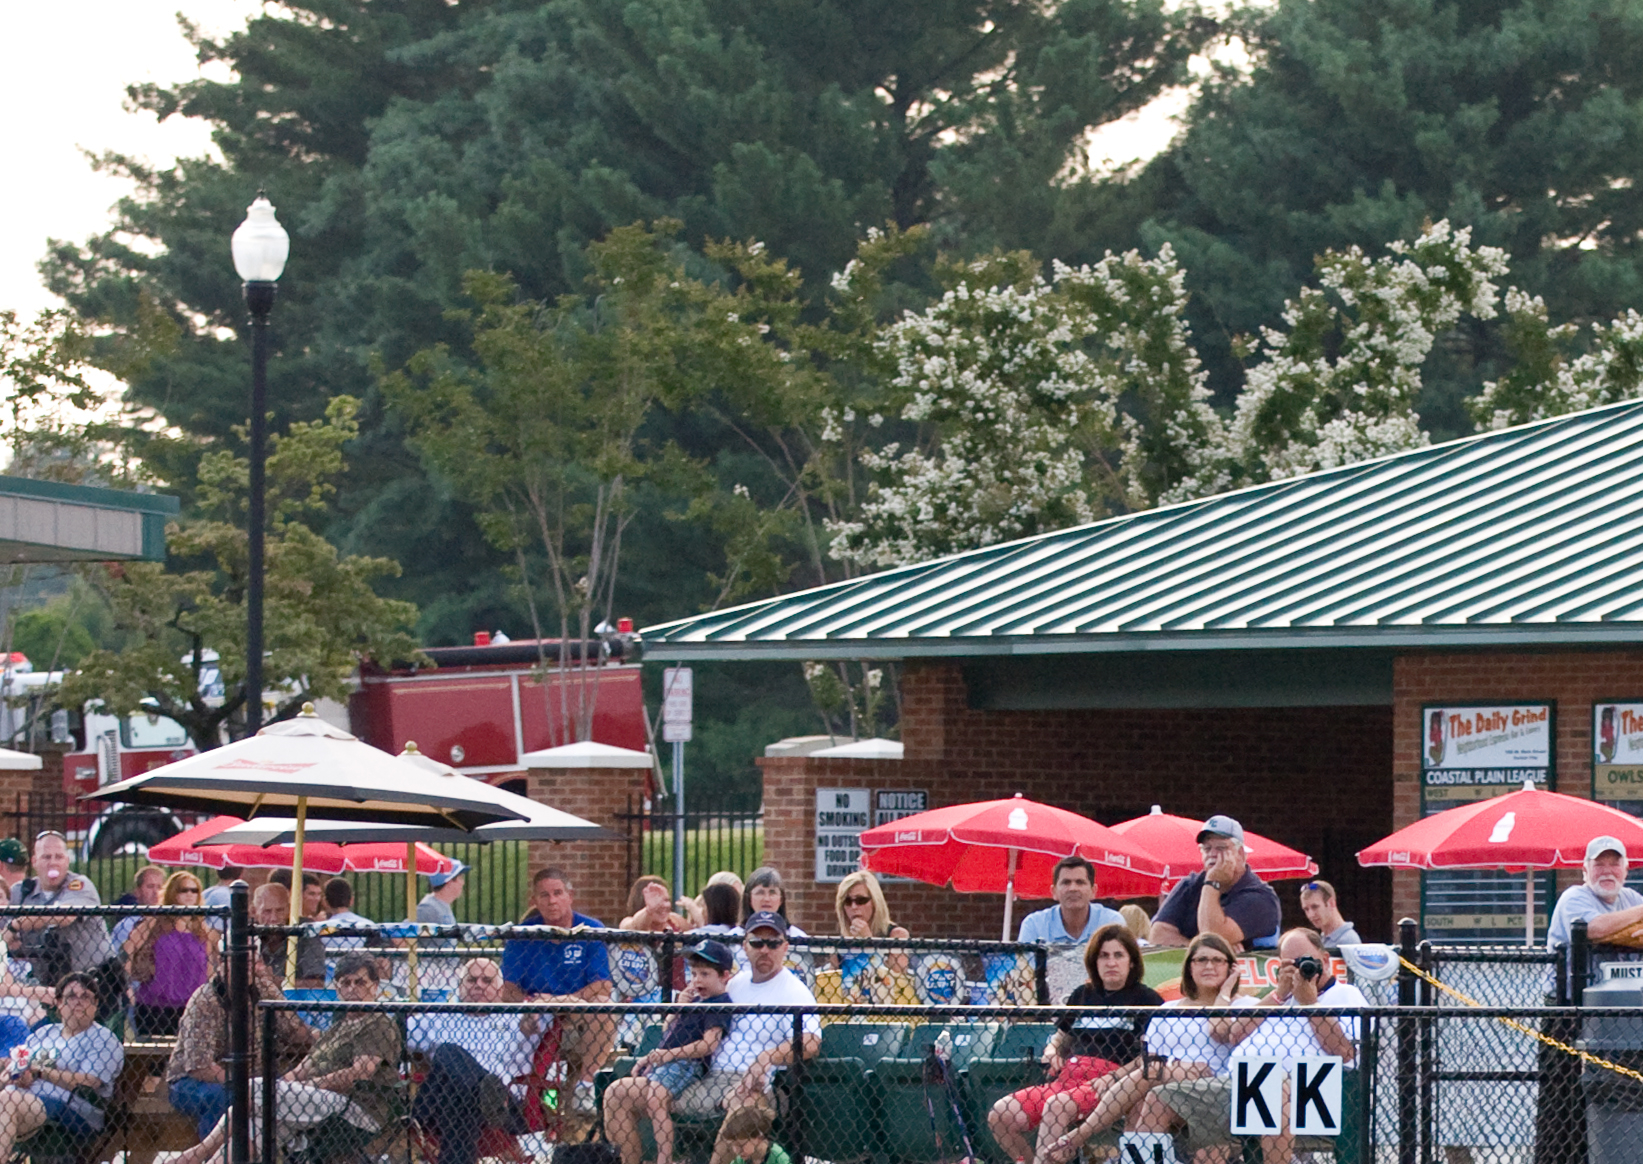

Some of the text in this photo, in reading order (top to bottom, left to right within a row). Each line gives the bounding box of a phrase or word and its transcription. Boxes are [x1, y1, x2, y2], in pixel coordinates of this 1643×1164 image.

[1449, 708, 1547, 738] The Daily Grind
[1427, 770, 1546, 784] COASTAL PLAIN LEAGUE
[836, 793, 850, 808] NO
[879, 793, 925, 808] NOTICE
[819, 812, 867, 826] SMOKING
[818, 835, 829, 847] NO
[825, 850, 847, 862] FOOD
[1426, 917, 1454, 926] SOUTH
[1236, 1062, 1277, 1128] K
[1296, 1062, 1337, 1128] K
